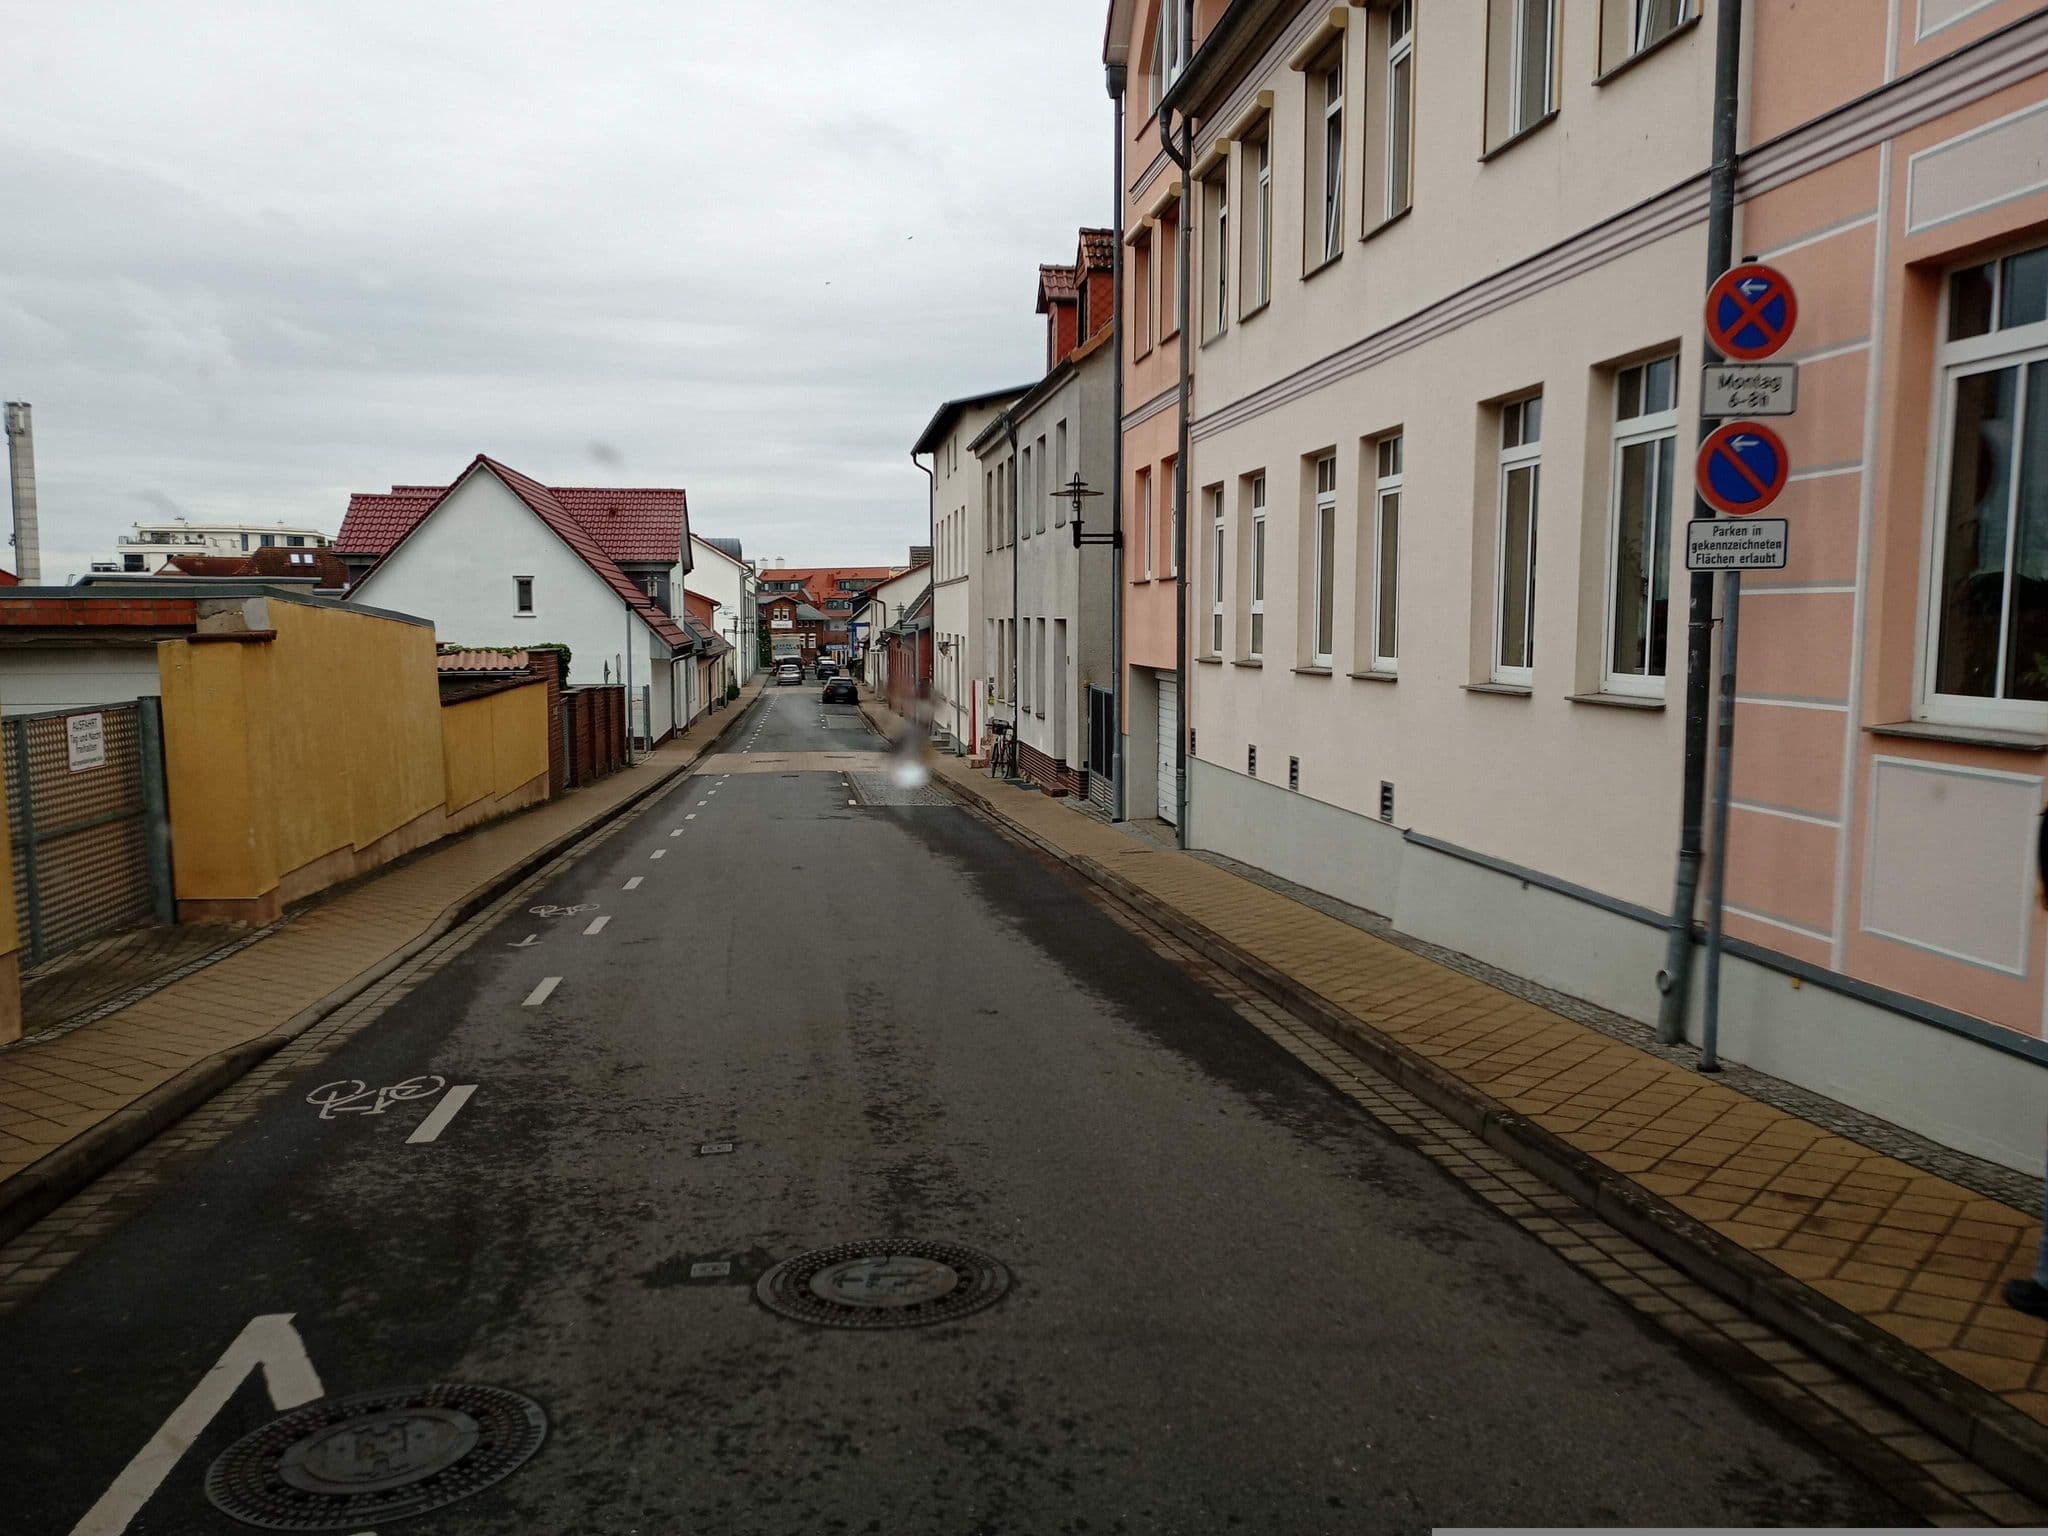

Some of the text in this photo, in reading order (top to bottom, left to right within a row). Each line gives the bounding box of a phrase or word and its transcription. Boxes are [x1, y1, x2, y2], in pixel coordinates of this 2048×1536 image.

[1718, 374, 1782, 393] Montag
[1712, 525, 1762, 537] Parken in
[1691, 539, 1782, 554] gekennzeichneten
[1696, 552, 1776, 565] Flächen erlaubt
